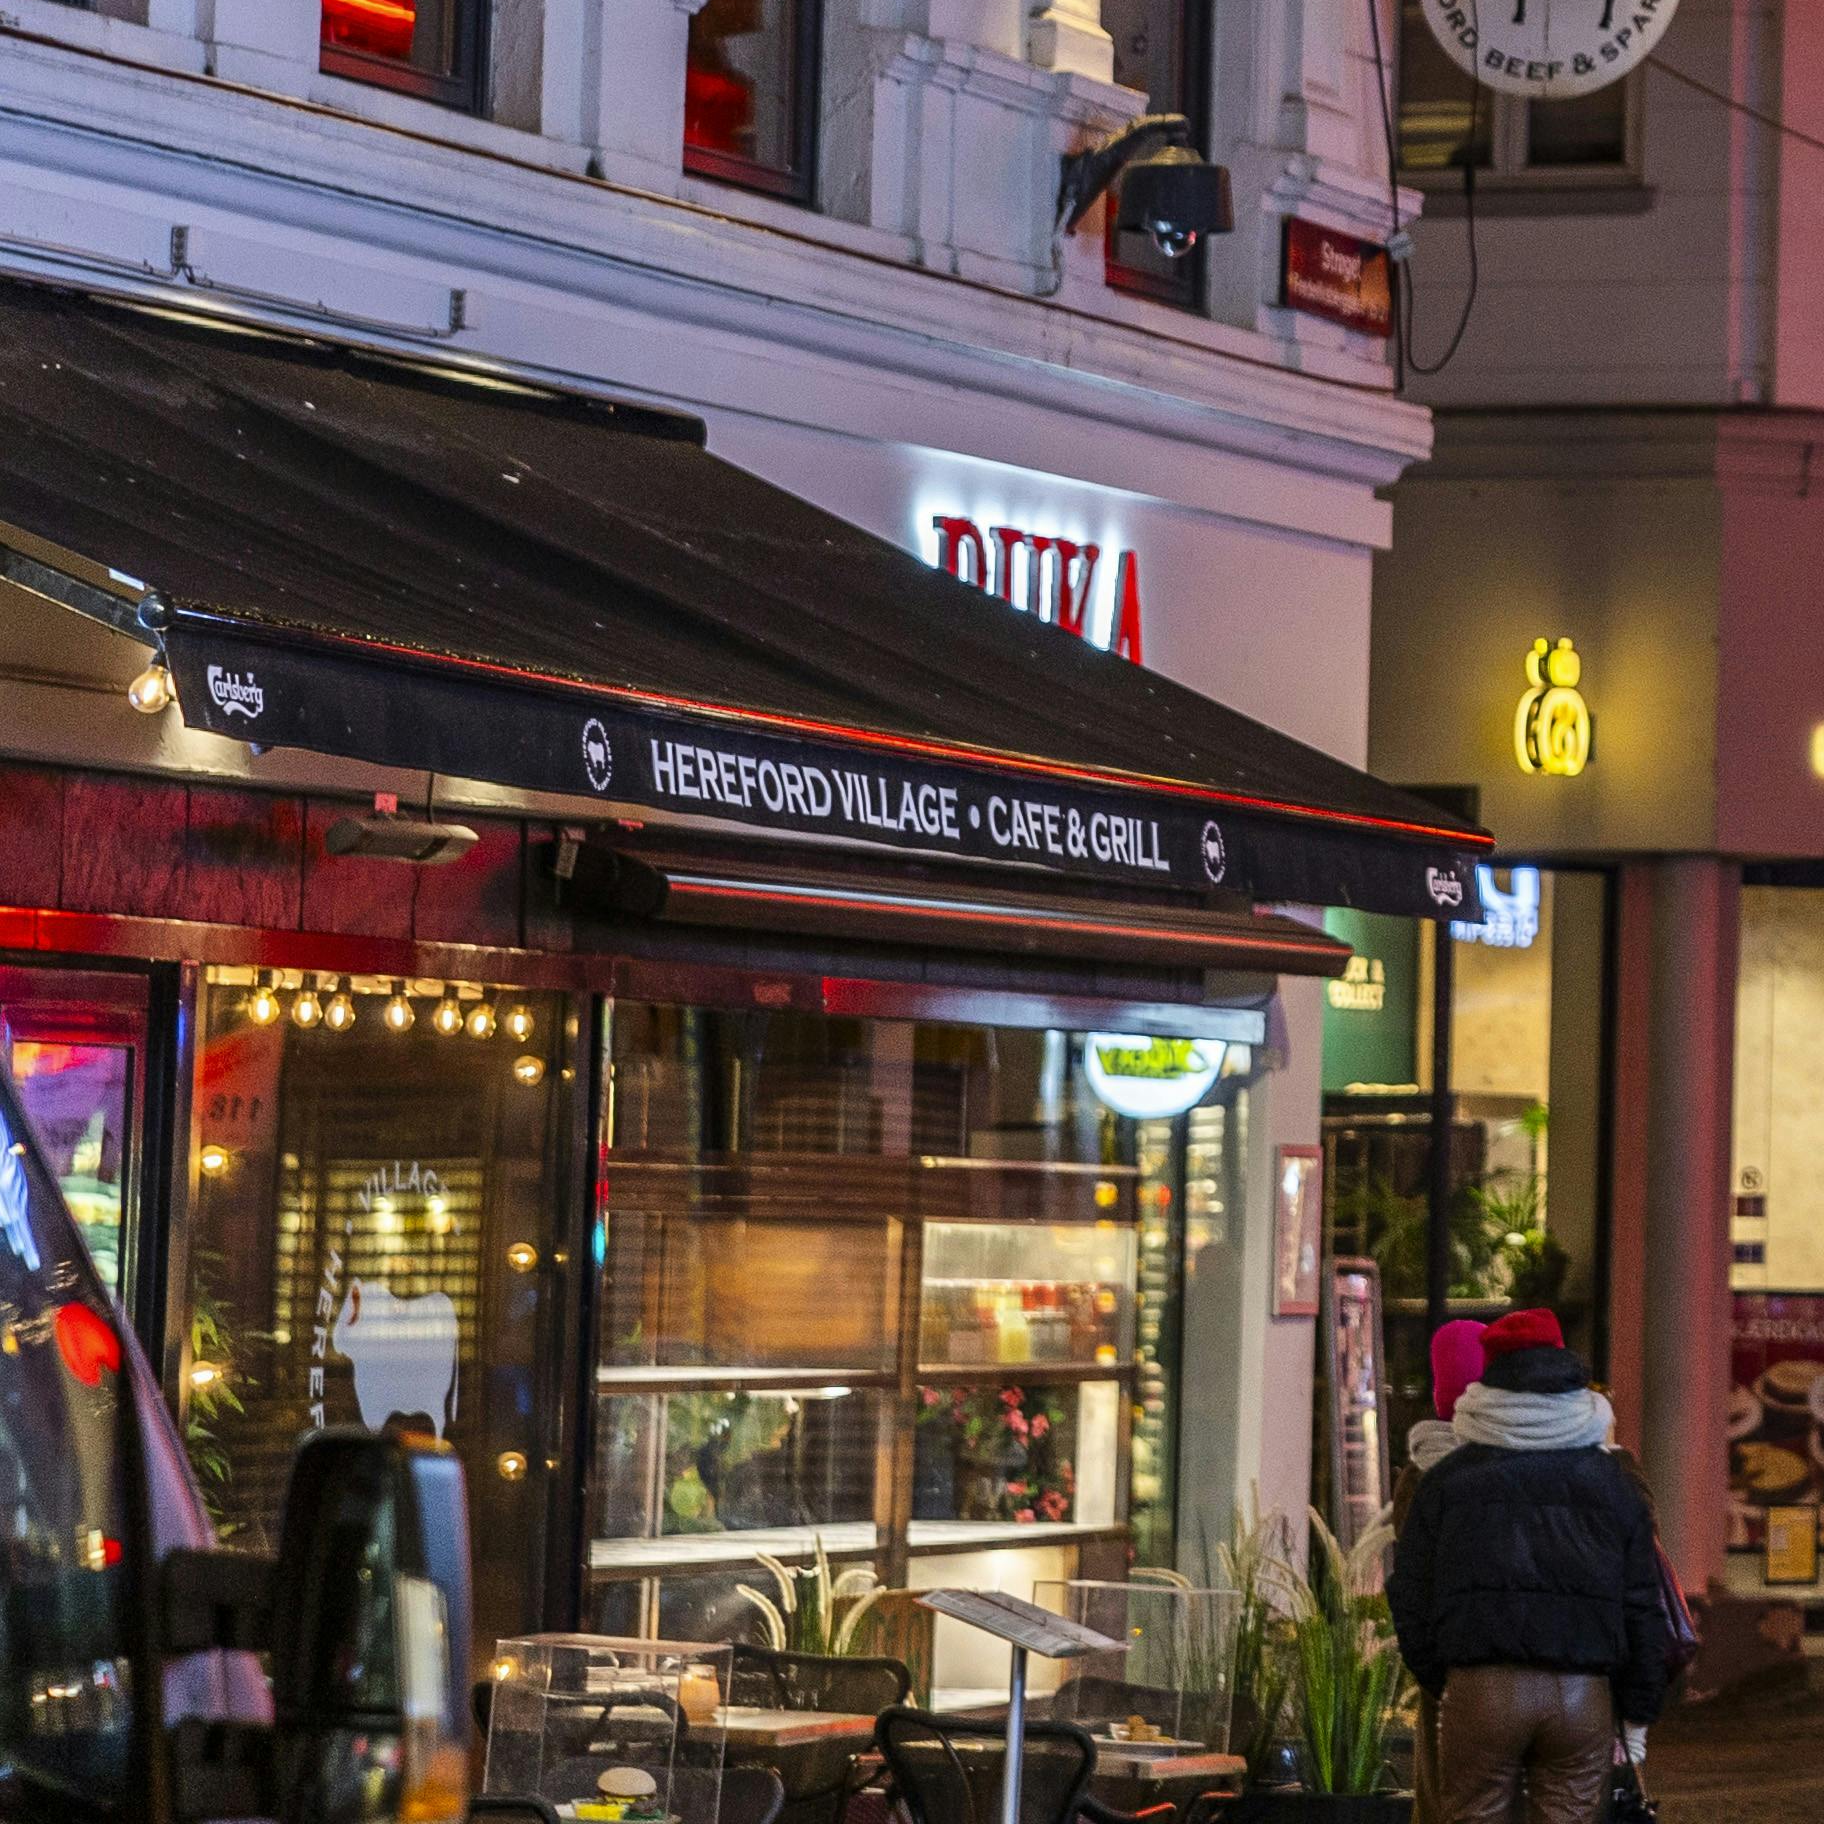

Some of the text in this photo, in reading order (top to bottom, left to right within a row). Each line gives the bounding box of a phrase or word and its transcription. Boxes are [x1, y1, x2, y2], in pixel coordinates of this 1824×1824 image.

[1485, 48, 1563, 81] BEEF
[1573, 52, 1596, 75] &
[206, 663, 265, 719] Carlsberg
[650, 738, 832, 818] HEREFORD
[832, 770, 961, 840] VILLAGE
[988, 795, 1063, 858] CAFE
[1067, 812, 1088, 858] &
[1090, 812, 1170, 873] GRILL
[309, 1248, 343, 1429] HEREF
